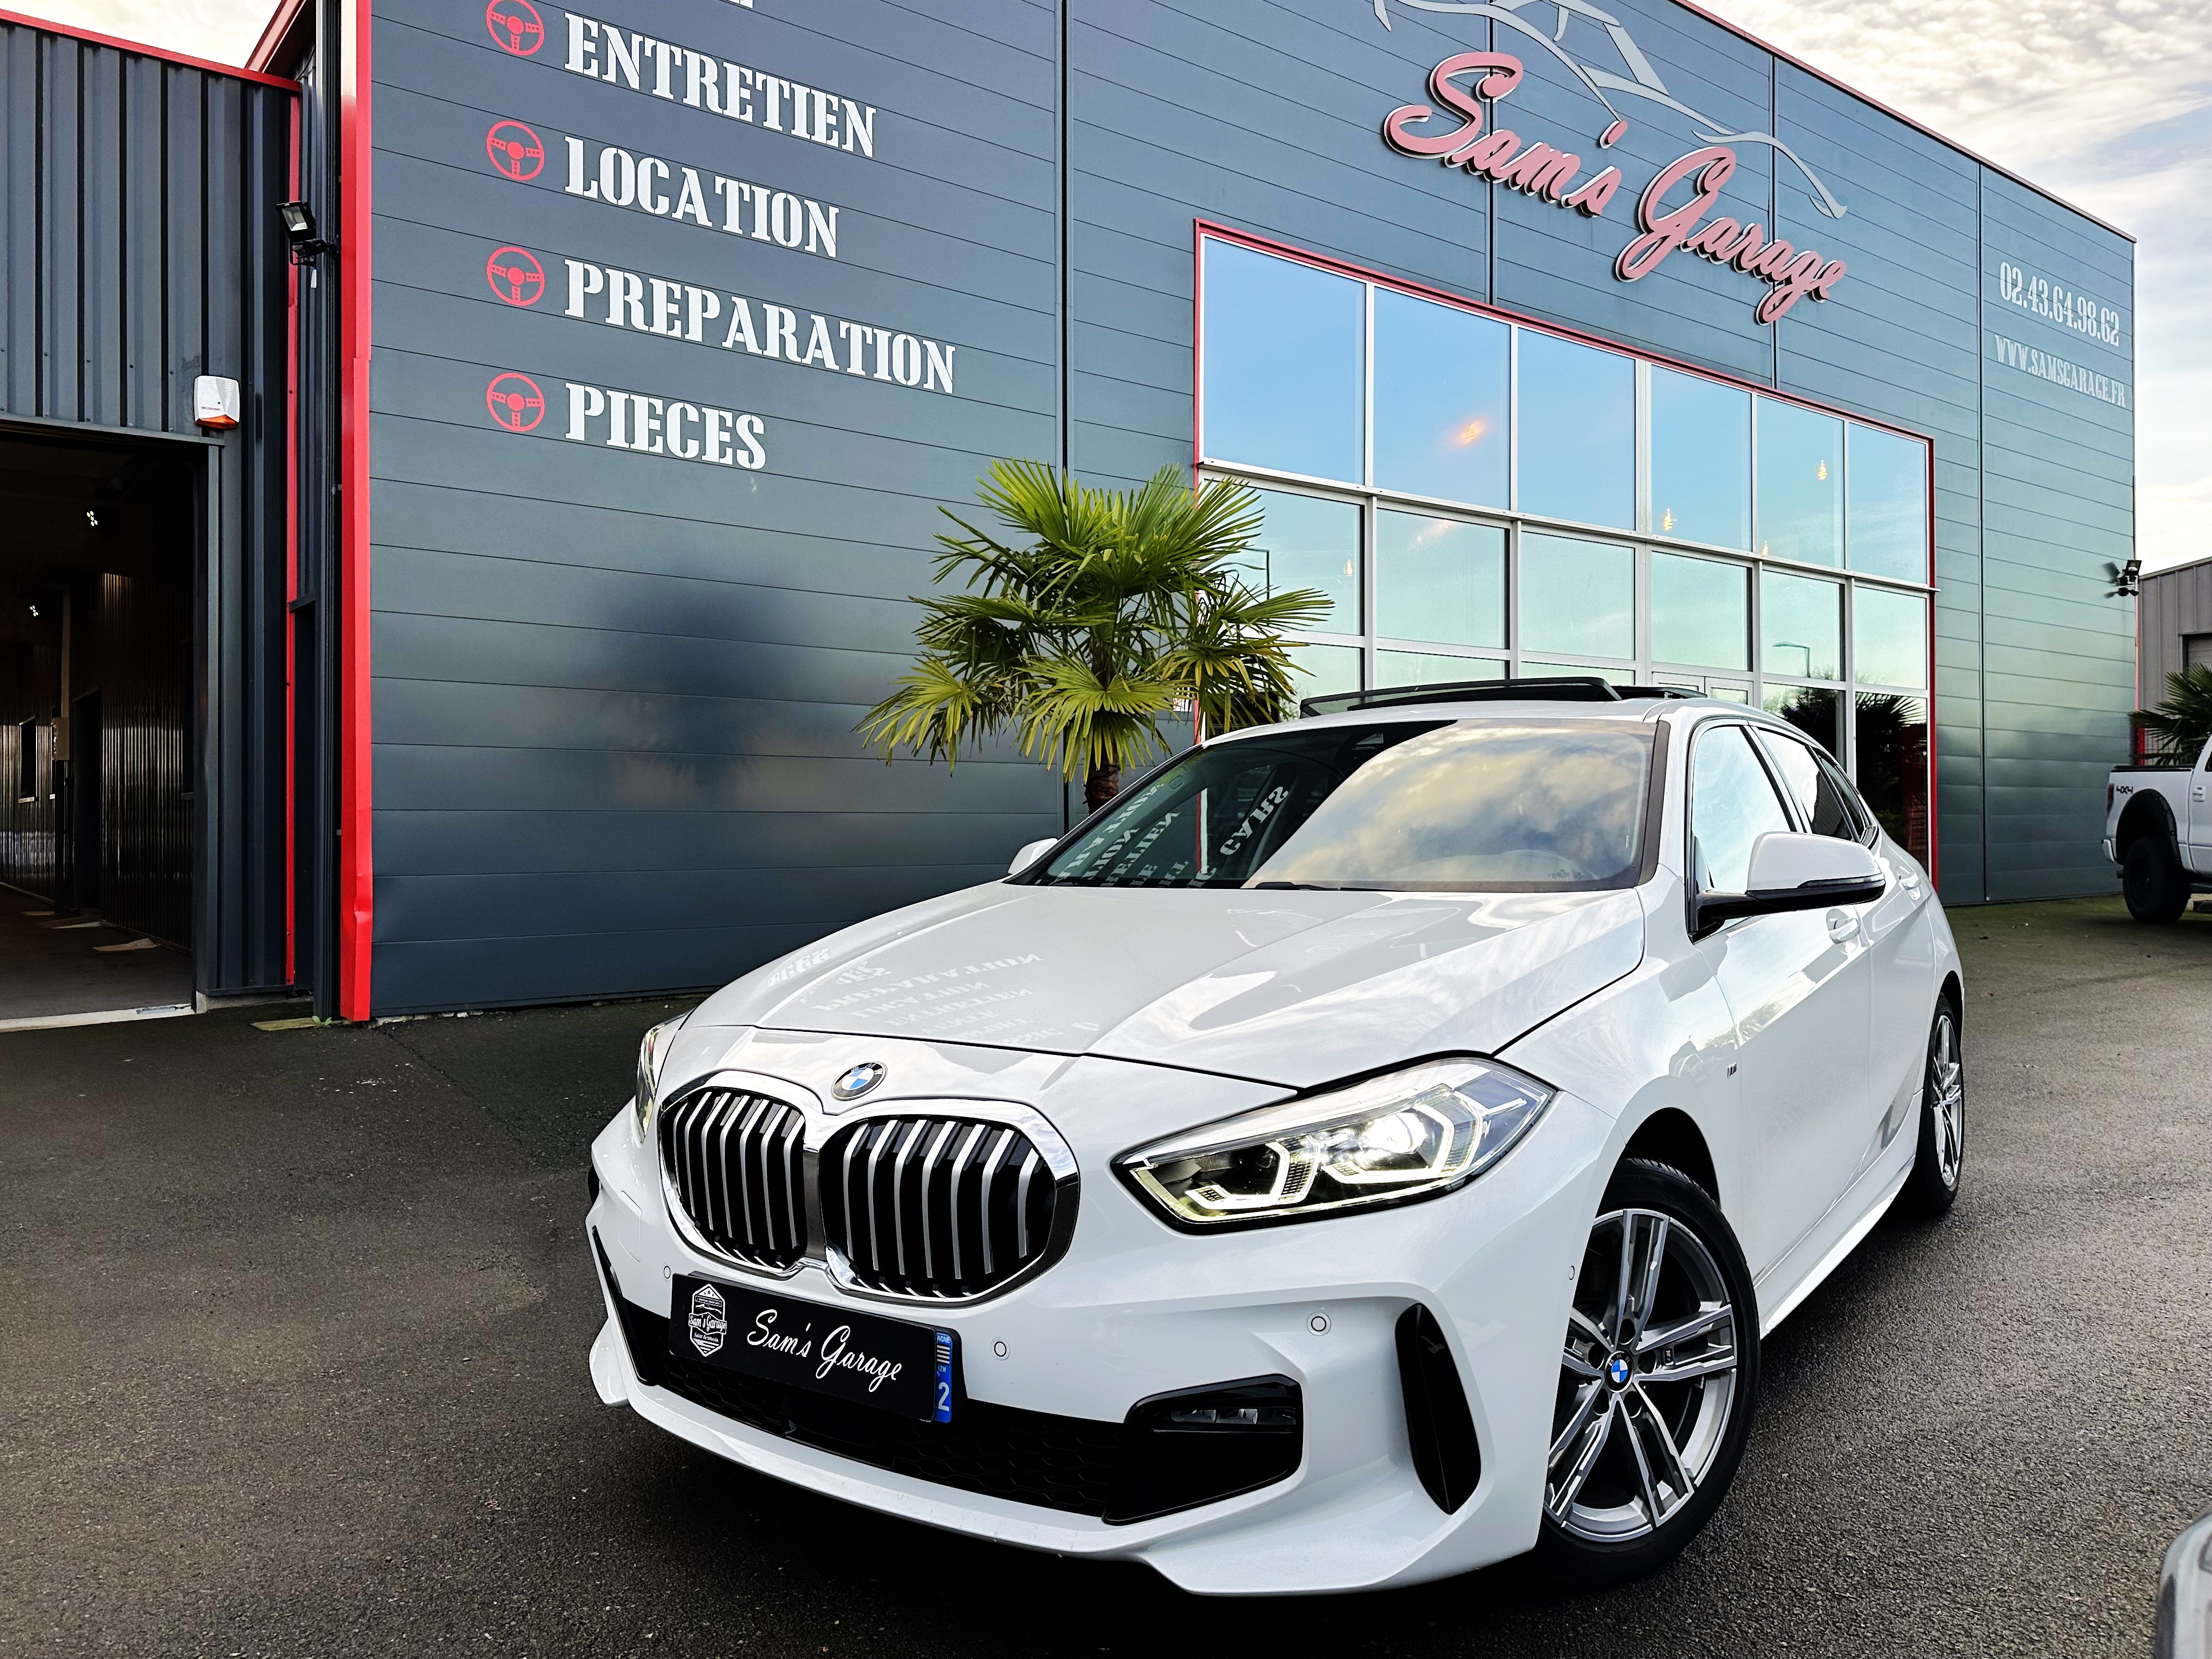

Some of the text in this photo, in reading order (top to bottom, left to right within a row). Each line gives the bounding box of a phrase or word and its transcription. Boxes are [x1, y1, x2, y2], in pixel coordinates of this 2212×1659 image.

[564, 12, 877, 158] ENTRETIEN
[564, 135, 840, 258] LOCATION
[1384, 51, 1848, 326] Sam's Garage
[564, 258, 956, 395] PREPARATION
[2000, 261, 2119, 348] 02.43.64.98.62
[1995, 334, 2126, 408] WWW.SAMSGARAGE.FR
[564, 382, 766, 470] PIECES
[689, 1314, 727, 1332] Sam's Garage
[747, 1309, 902, 1393] Sam's Garage
